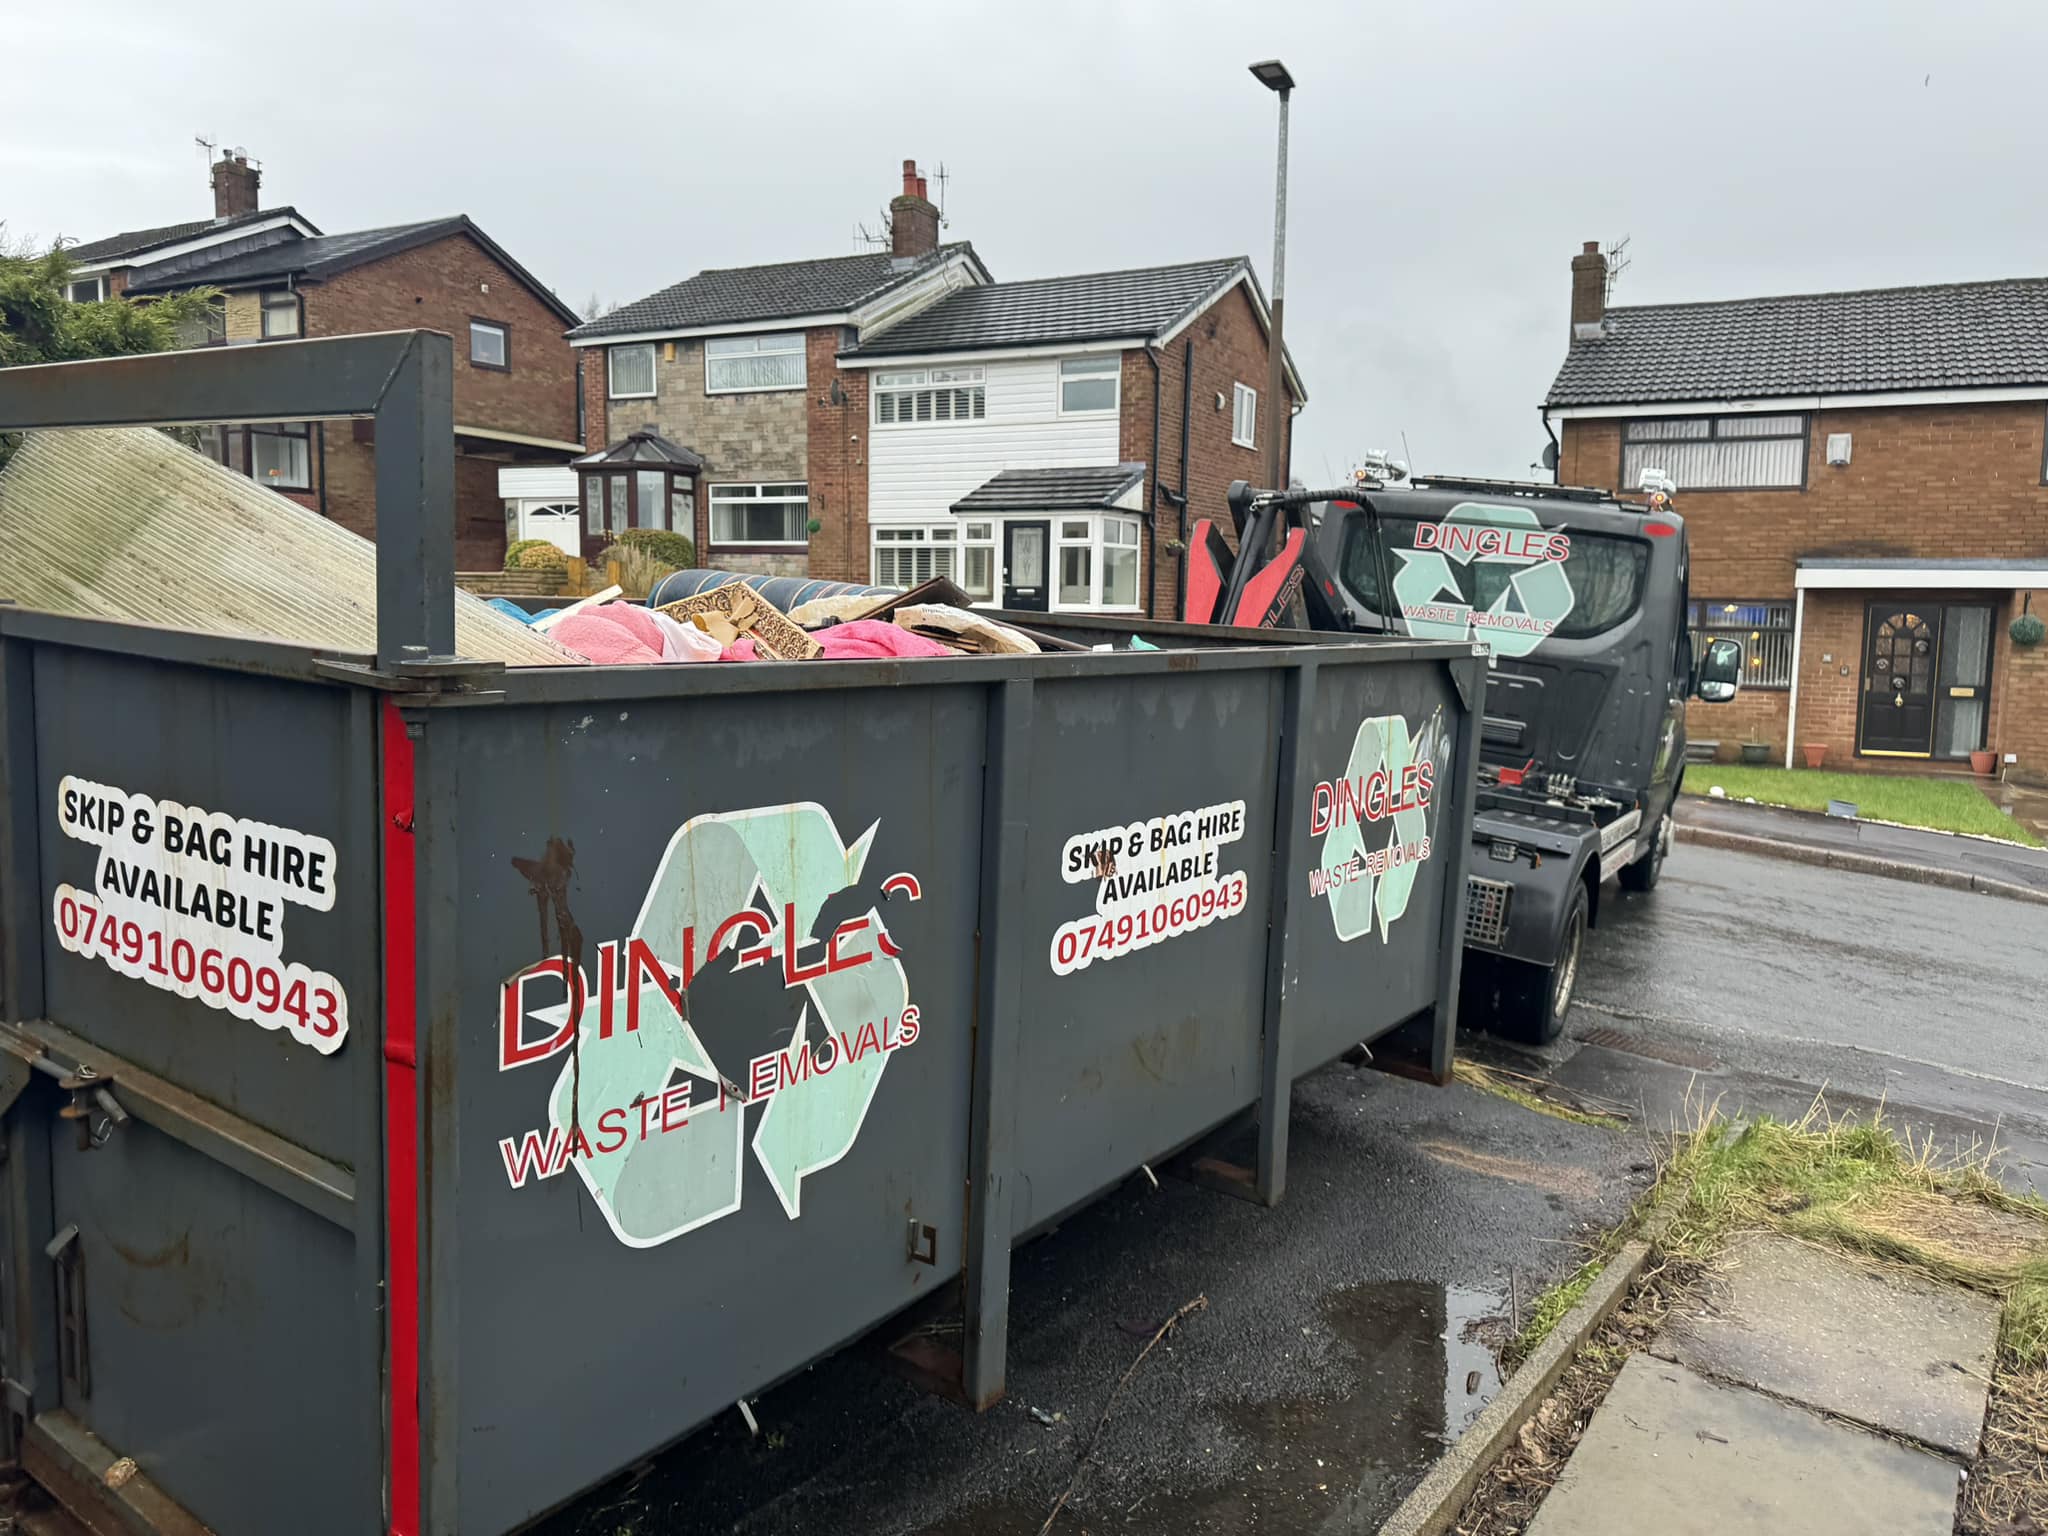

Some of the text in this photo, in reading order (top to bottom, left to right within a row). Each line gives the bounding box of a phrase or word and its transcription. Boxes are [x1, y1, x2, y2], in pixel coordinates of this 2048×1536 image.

[1415, 522, 1571, 561] DINGLES
[1403, 605, 1554, 633] WASTE REMOVALS
[1311, 761, 1434, 835] DINGLES
[64, 789, 326, 894] SKIP & BAG HIRE
[1068, 810, 1241, 872] SKIP & BAG HIRE
[1103, 852, 1213, 904] AVAILABLE
[1309, 837, 1431, 897] WASTE REMOVALS
[102, 857, 274, 941] AVAILABLE
[1057, 880, 1243, 964] 07491060943
[60, 897, 339, 1038] 07491060943
[503, 1007, 919, 1184] WASTE EMOVALS
